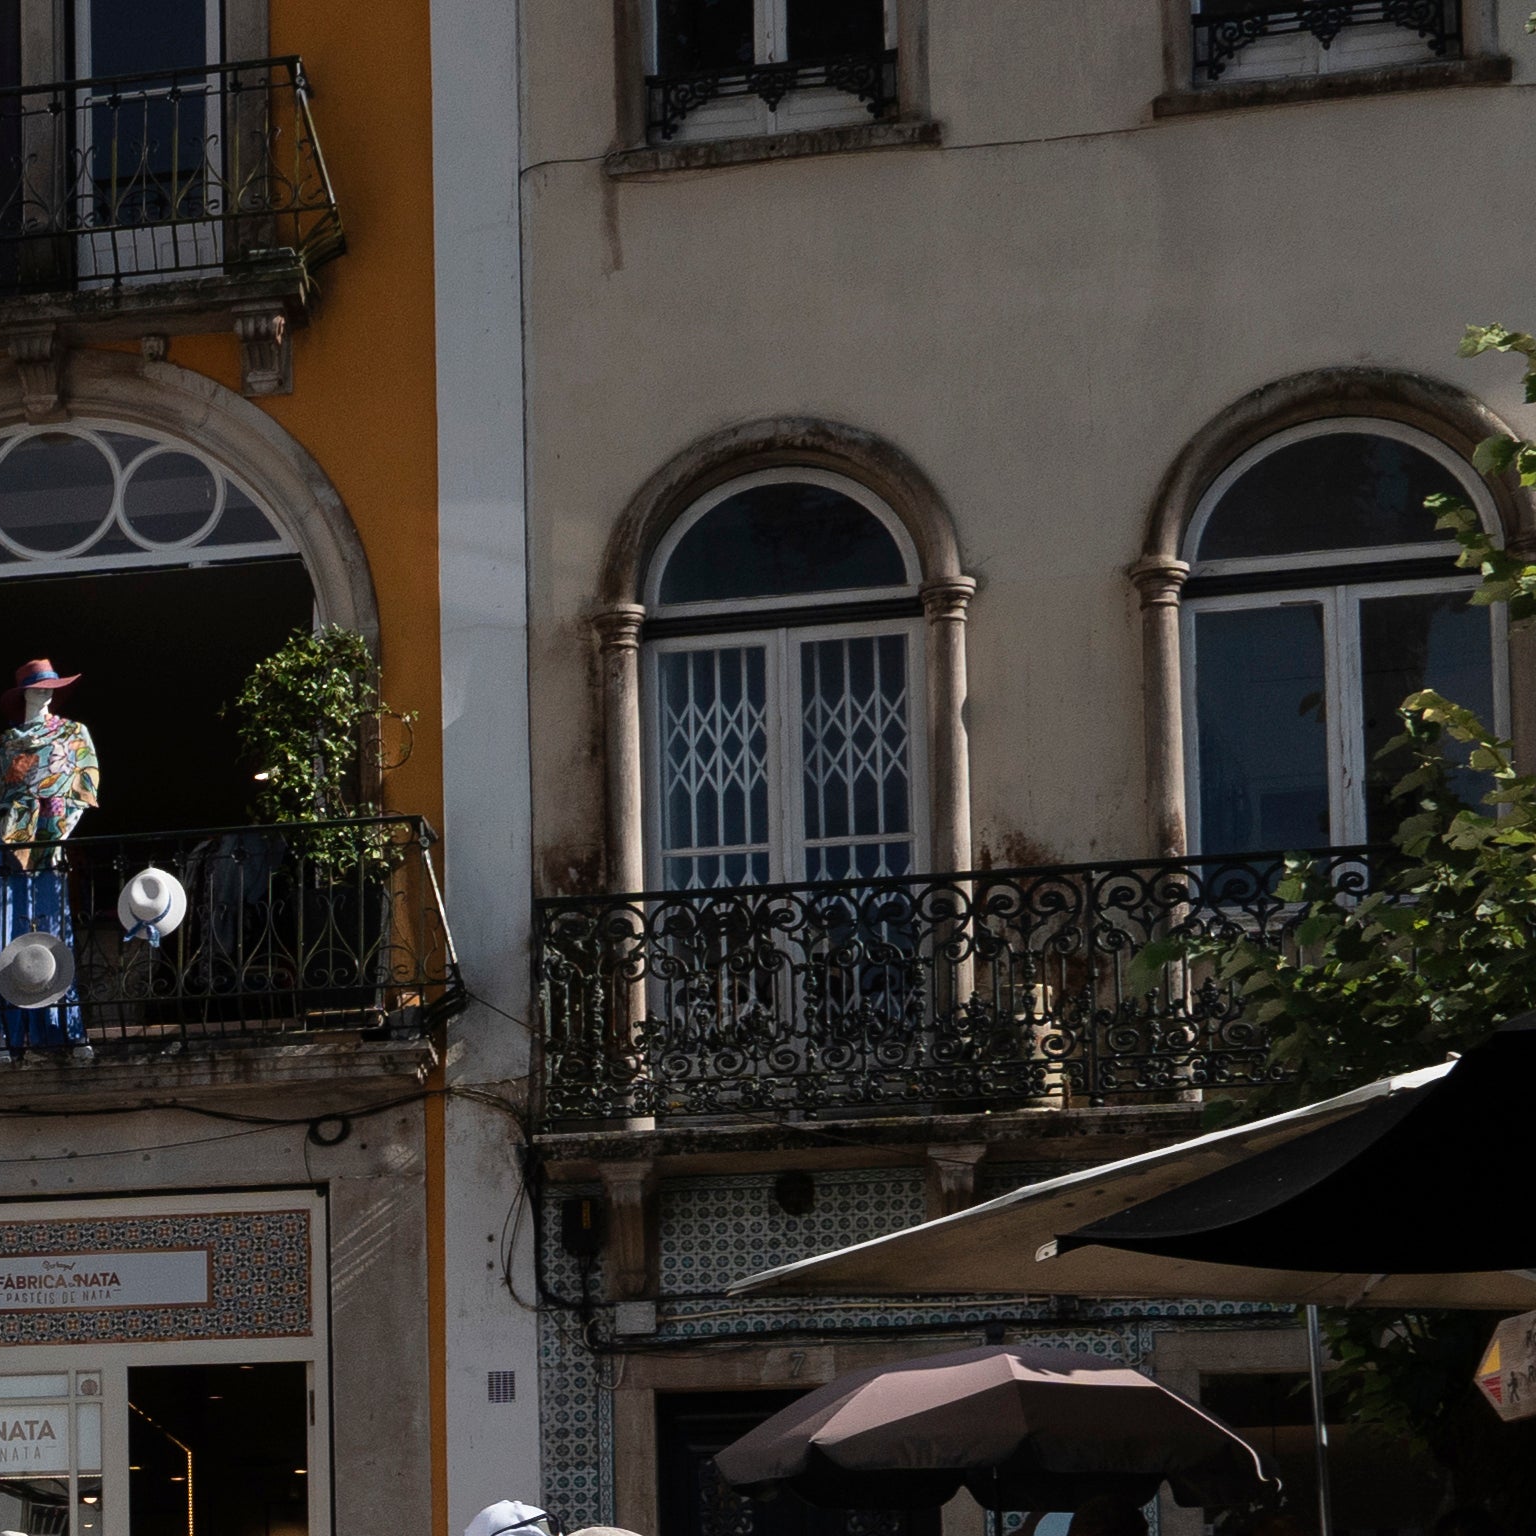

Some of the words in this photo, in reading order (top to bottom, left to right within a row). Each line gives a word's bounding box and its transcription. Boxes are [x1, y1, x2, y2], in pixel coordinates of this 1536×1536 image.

[72, 1271, 122, 1288] NATA
[6, 1290, 56, 1305] PASTÉIS
[62, 1291, 76, 1304] DE
[82, 1289, 112, 1302] NATA
[0, 1445, 42, 1463] NATA
